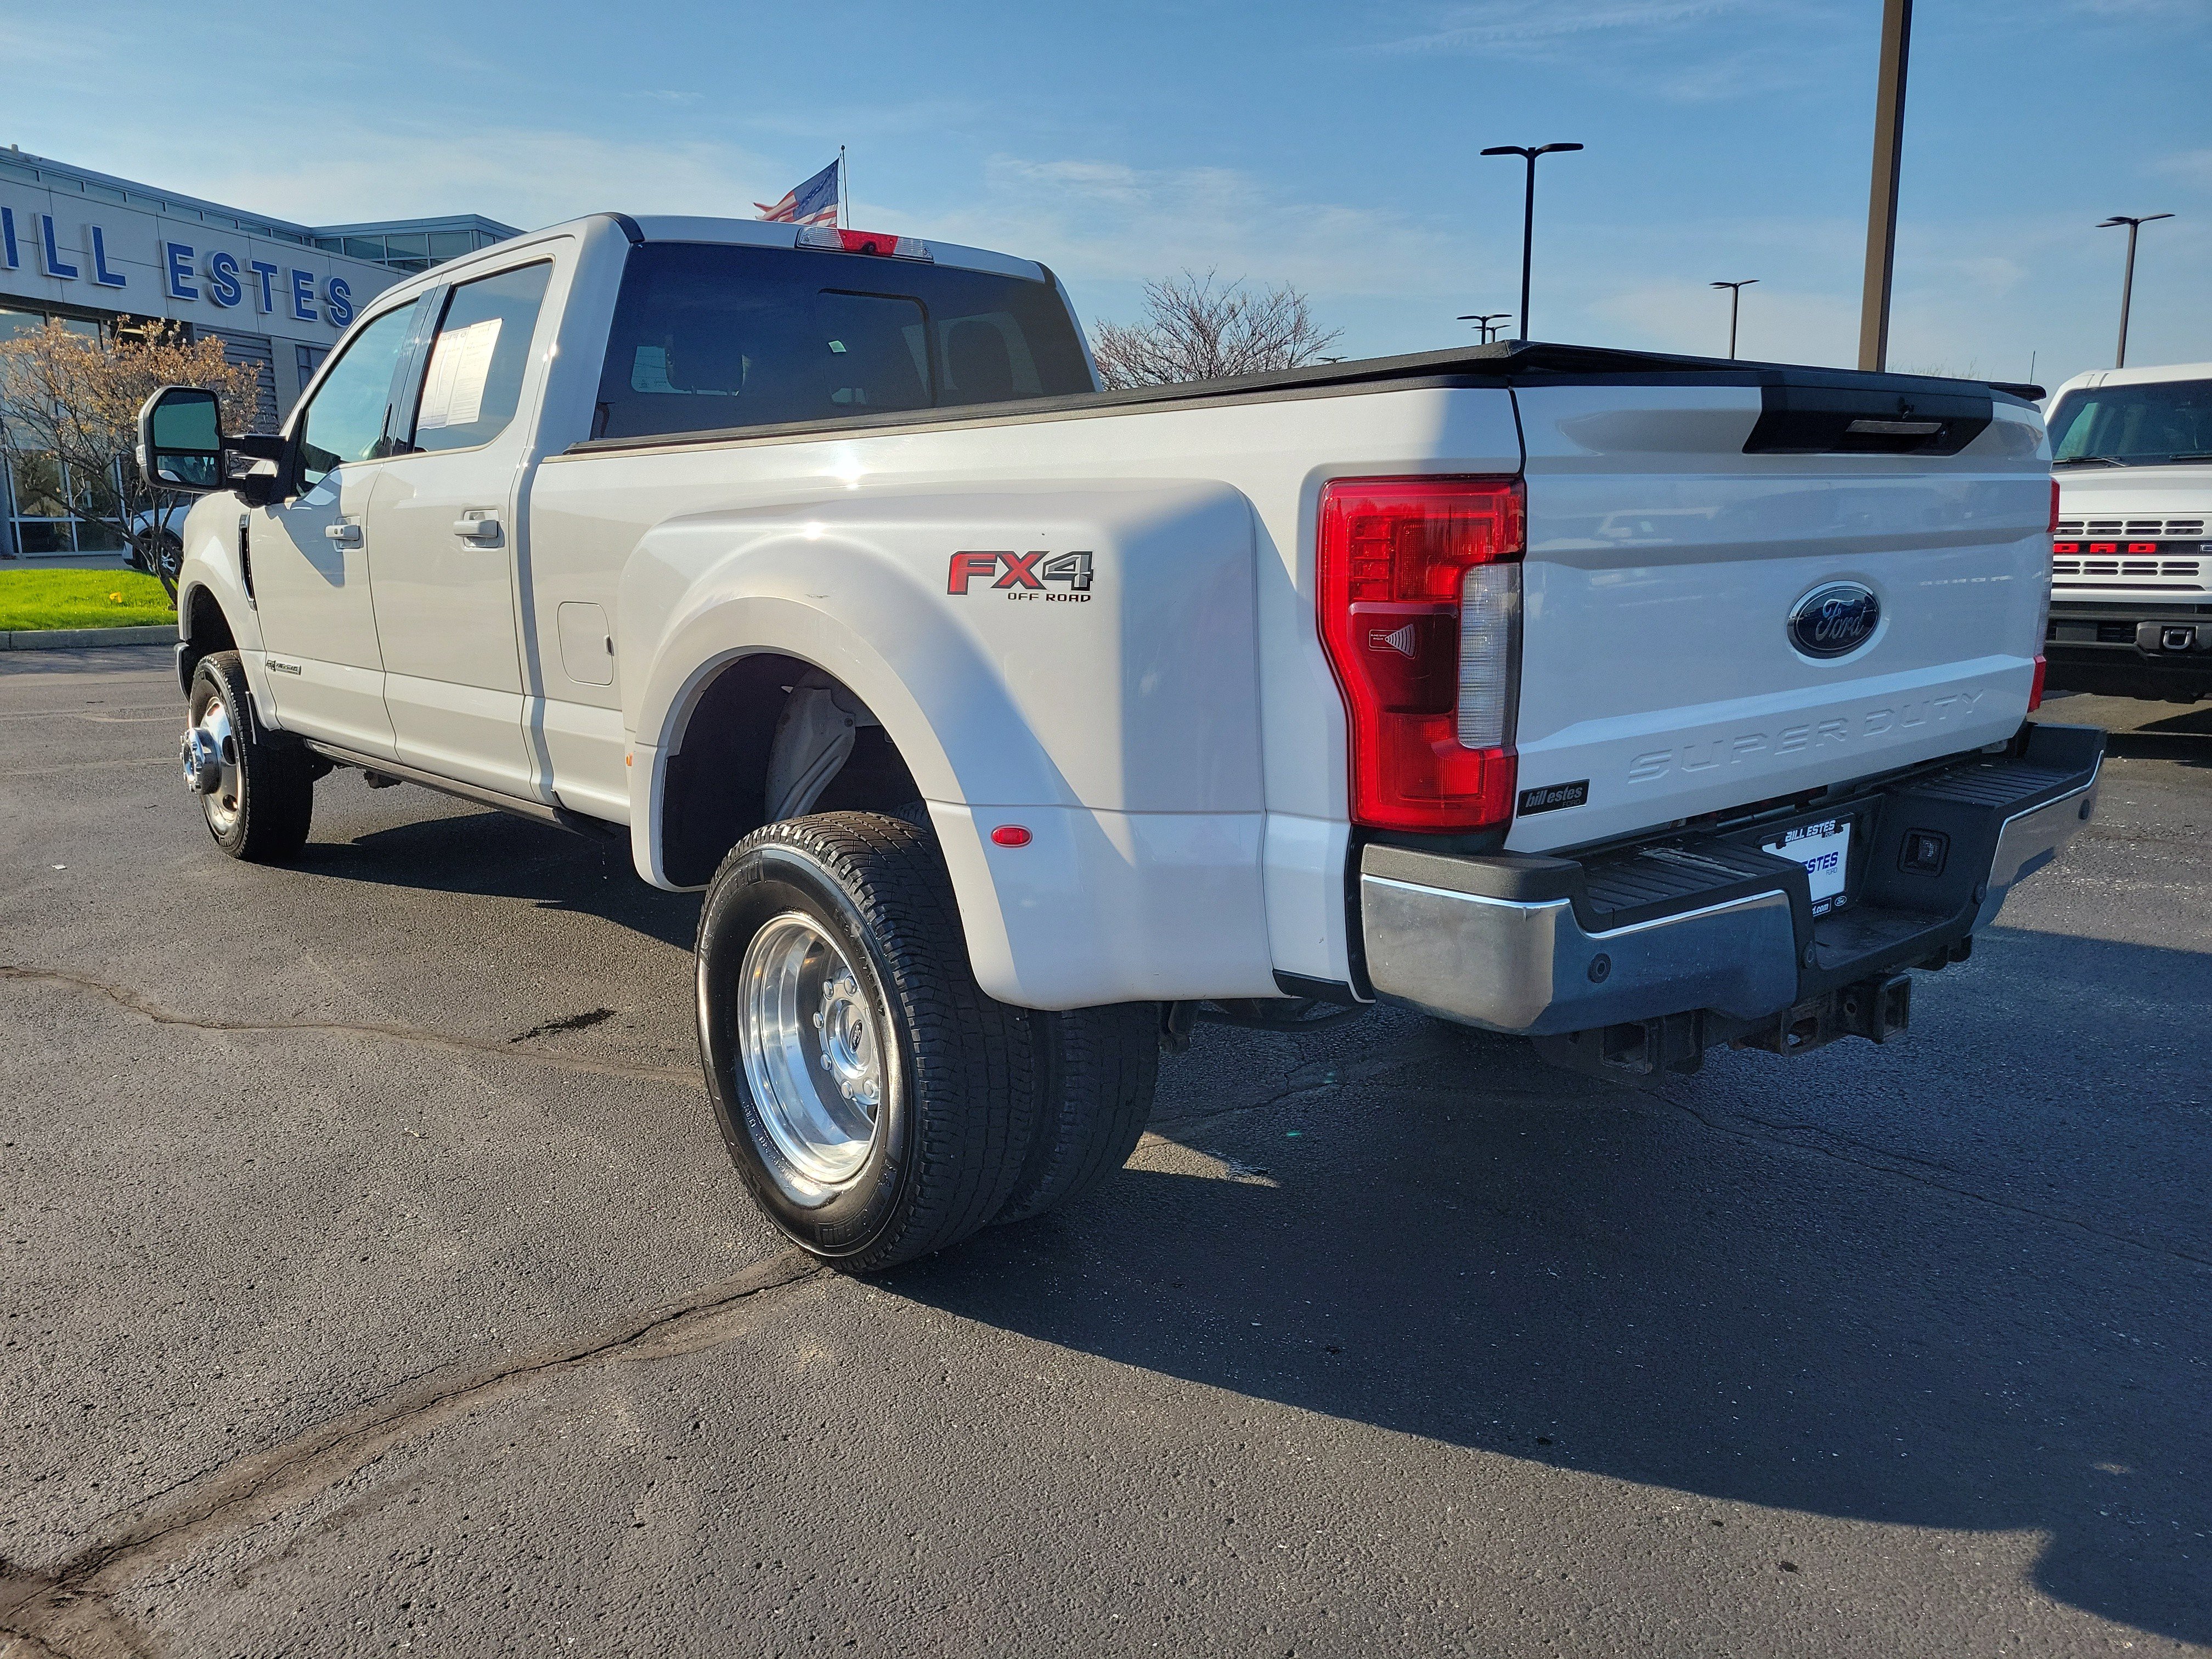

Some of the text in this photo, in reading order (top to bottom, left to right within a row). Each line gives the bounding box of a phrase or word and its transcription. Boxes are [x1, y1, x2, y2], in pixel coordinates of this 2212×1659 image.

[1, 206, 354, 328] ILL ESTES
[2053, 543, 2156, 554] ORD
[947, 550, 1094, 595] FX4
[1008, 592, 1091, 603] OFF ROAD
[1816, 598, 1866, 641] Ford
[1628, 689, 1983, 784] SUPER DUTY
[1526, 786, 1583, 808] bill estes
[1562, 799, 1581, 808] FORD
[1785, 820, 1836, 843] BILL ESTES
[1826, 867, 1838, 875] FORD
